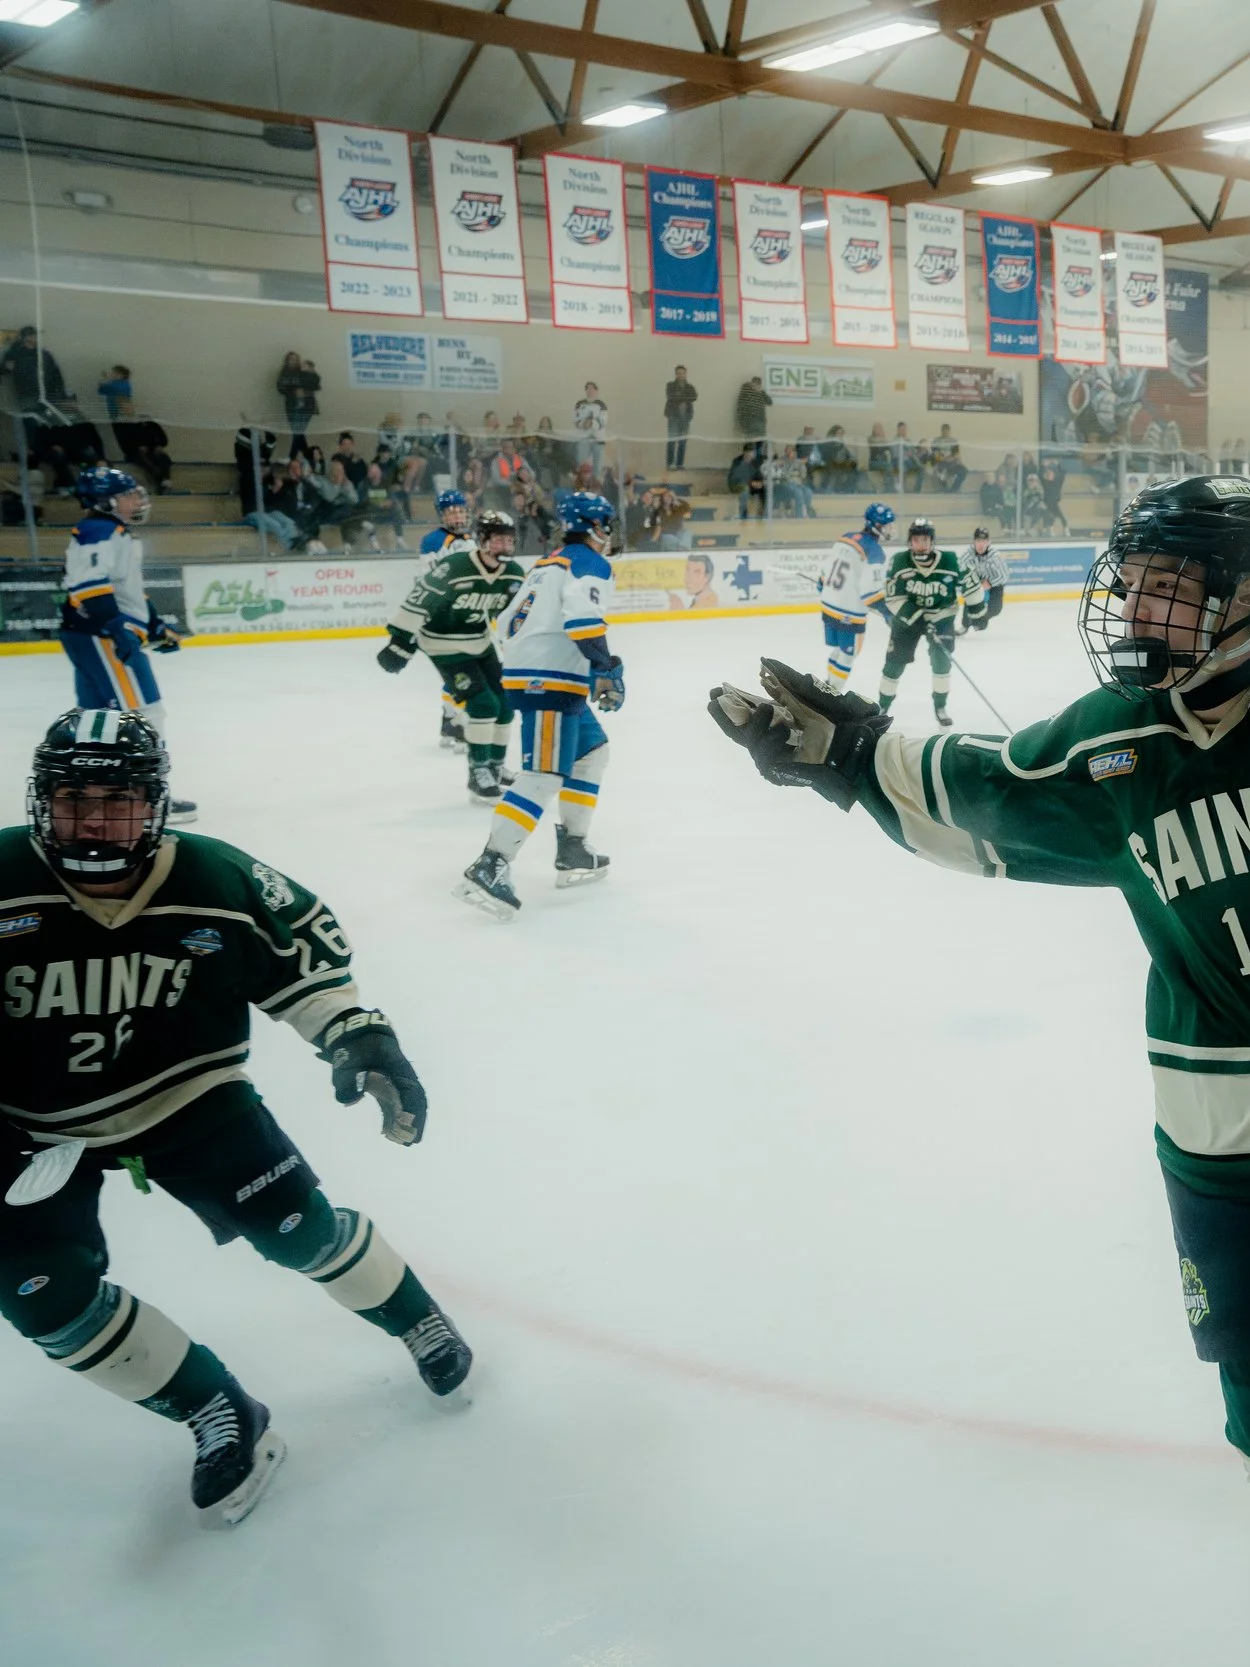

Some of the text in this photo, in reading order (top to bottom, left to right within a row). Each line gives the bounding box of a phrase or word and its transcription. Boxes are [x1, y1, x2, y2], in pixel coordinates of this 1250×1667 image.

[344, 135, 383, 151] North
[337, 148, 391, 166] Division
[455, 150, 491, 165] North
[449, 163, 499, 179] Division
[568, 167, 602, 181] North
[562, 179, 608, 195] Division
[339, 187, 400, 211] AJHL
[653, 192, 714, 210] Champions
[753, 194, 783, 206] North
[451, 200, 506, 223] AJHL
[749, 204, 788, 218] Division
[914, 210, 957, 225] REGULAR
[562, 212, 614, 233] AJHL
[334, 233, 409, 253] Champions
[659, 226, 712, 246] AJHL
[447, 244, 515, 262] Champions
[750, 237, 792, 255] AJHL
[841, 245, 882, 264] AJHL
[560, 255, 622, 272] Champions
[914, 253, 960, 274] AJHL
[340, 281, 370, 296] 2022
[383, 284, 411, 298] 2023
[746, 275, 800, 291] Champions
[838, 283, 887, 296] Champions
[452, 290, 479, 304] 2021
[491, 293, 519, 306] 2022
[910, 292, 963, 306] CHAMPIONS
[562, 300, 589, 313] 2018
[599, 302, 623, 315] 2019
[769, 367, 819, 388] GNS
[315, 568, 355, 581] OPEN
[826, 558, 851, 591] 15
[290, 582, 384, 598] YEAR ROUND
[905, 579, 948, 598] SAINTS
[452, 592, 509, 610] SAINTS
[70, 756, 123, 768] CCM
[293, 914, 352, 978] 26
[5, 952, 193, 1019] SAINTS
[235, 1153, 302, 1204] BAUER
